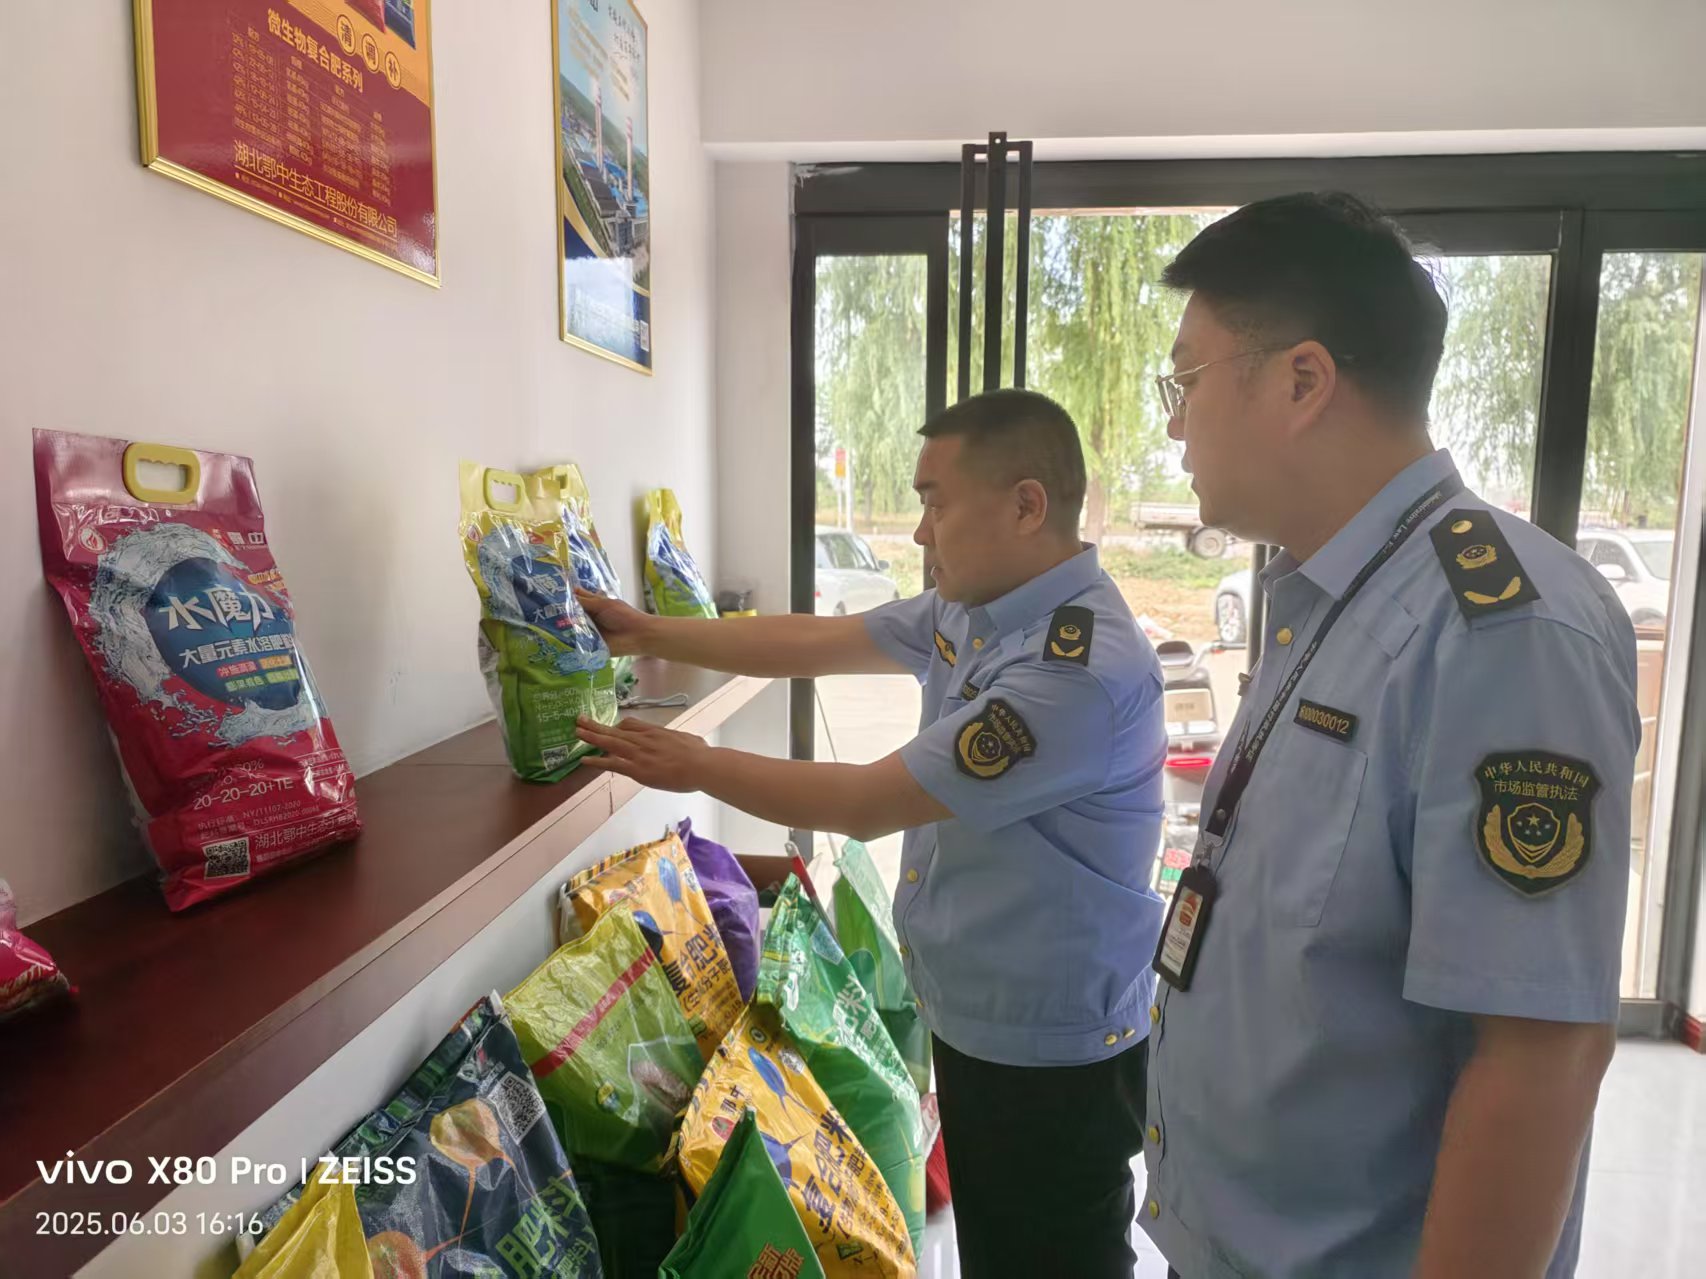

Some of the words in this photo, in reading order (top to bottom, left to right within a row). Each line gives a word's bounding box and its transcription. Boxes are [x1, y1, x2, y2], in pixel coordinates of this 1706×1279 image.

[267, 8, 364, 93] 微生物复合肥系列
[234, 139, 399, 239] 湖北鄂中生态工程股份有限公司
[158, 583, 276, 632] 水魔力
[1484, 759, 1590, 788] 中华人民共和国
[1494, 780, 1579, 801] 市场监管执法
